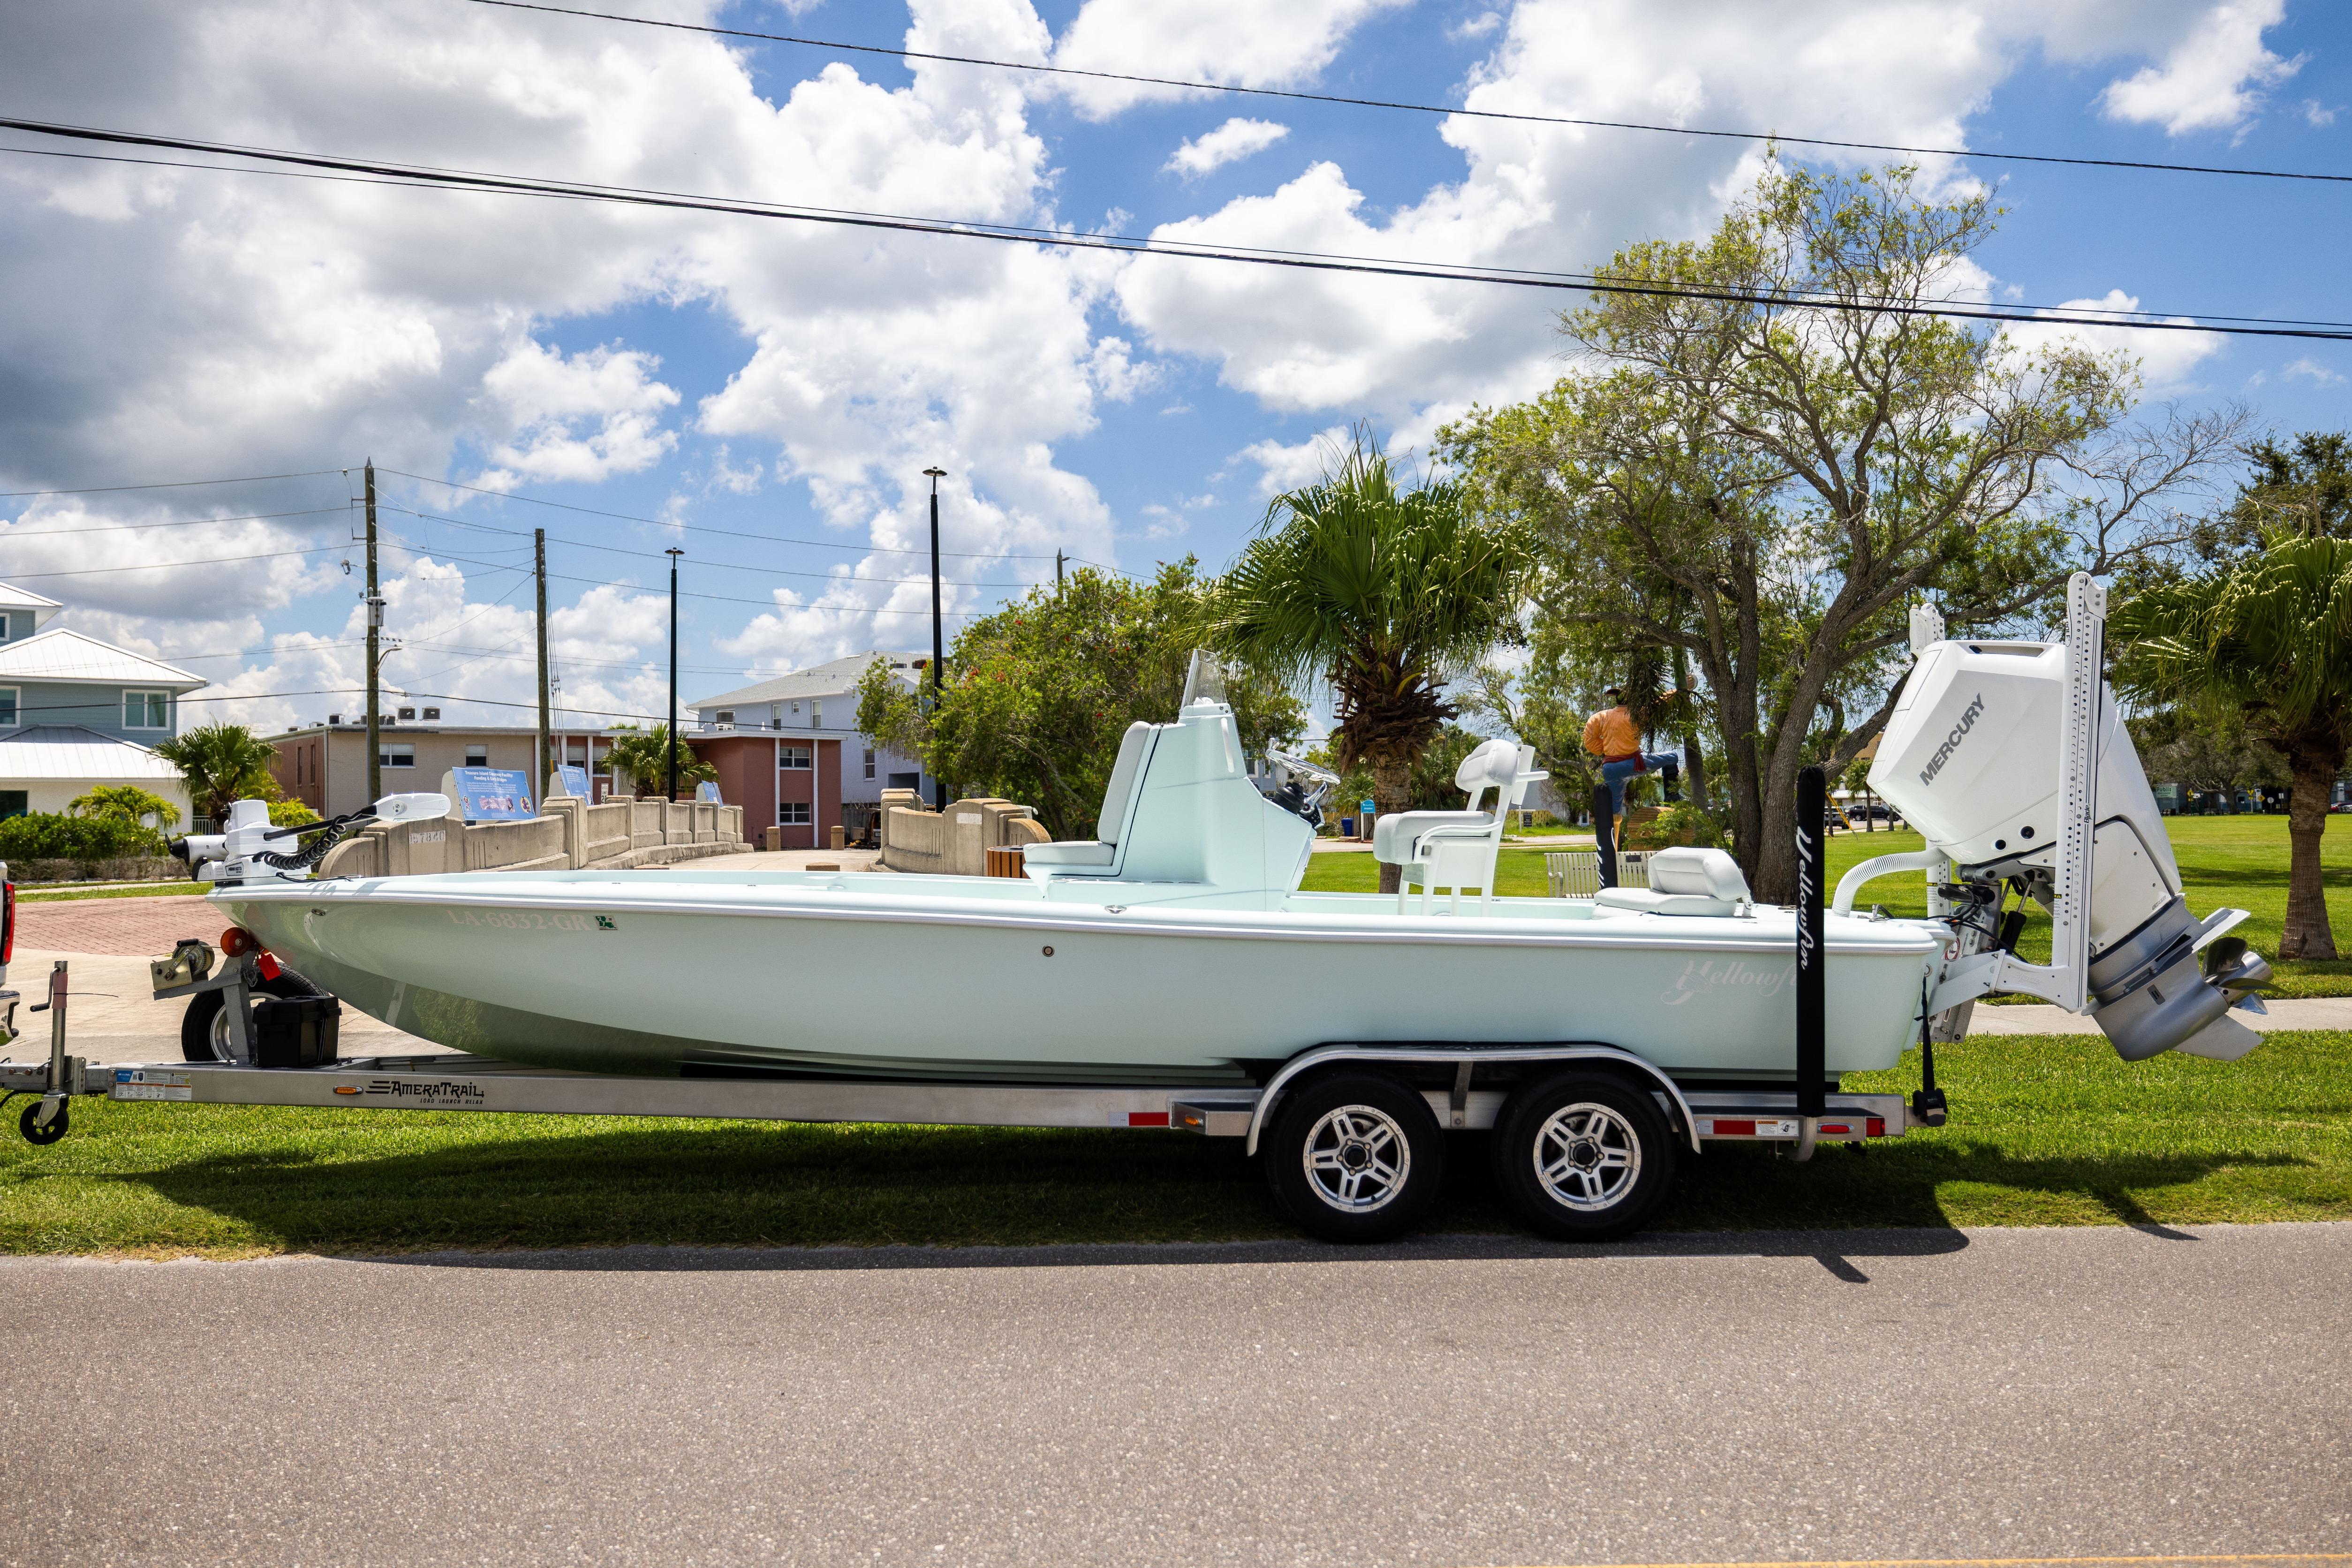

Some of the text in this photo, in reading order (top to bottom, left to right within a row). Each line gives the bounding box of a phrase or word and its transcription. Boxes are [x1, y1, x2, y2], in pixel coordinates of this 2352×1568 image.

[1919, 692, 1985, 787] MERCURY
[2084, 805, 2093, 824] Blade
[445, 909, 592, 931] LA-6832-GR
[1795, 826, 1815, 970] Yellowfin
[1660, 960, 1797, 1005] Yellowfi
